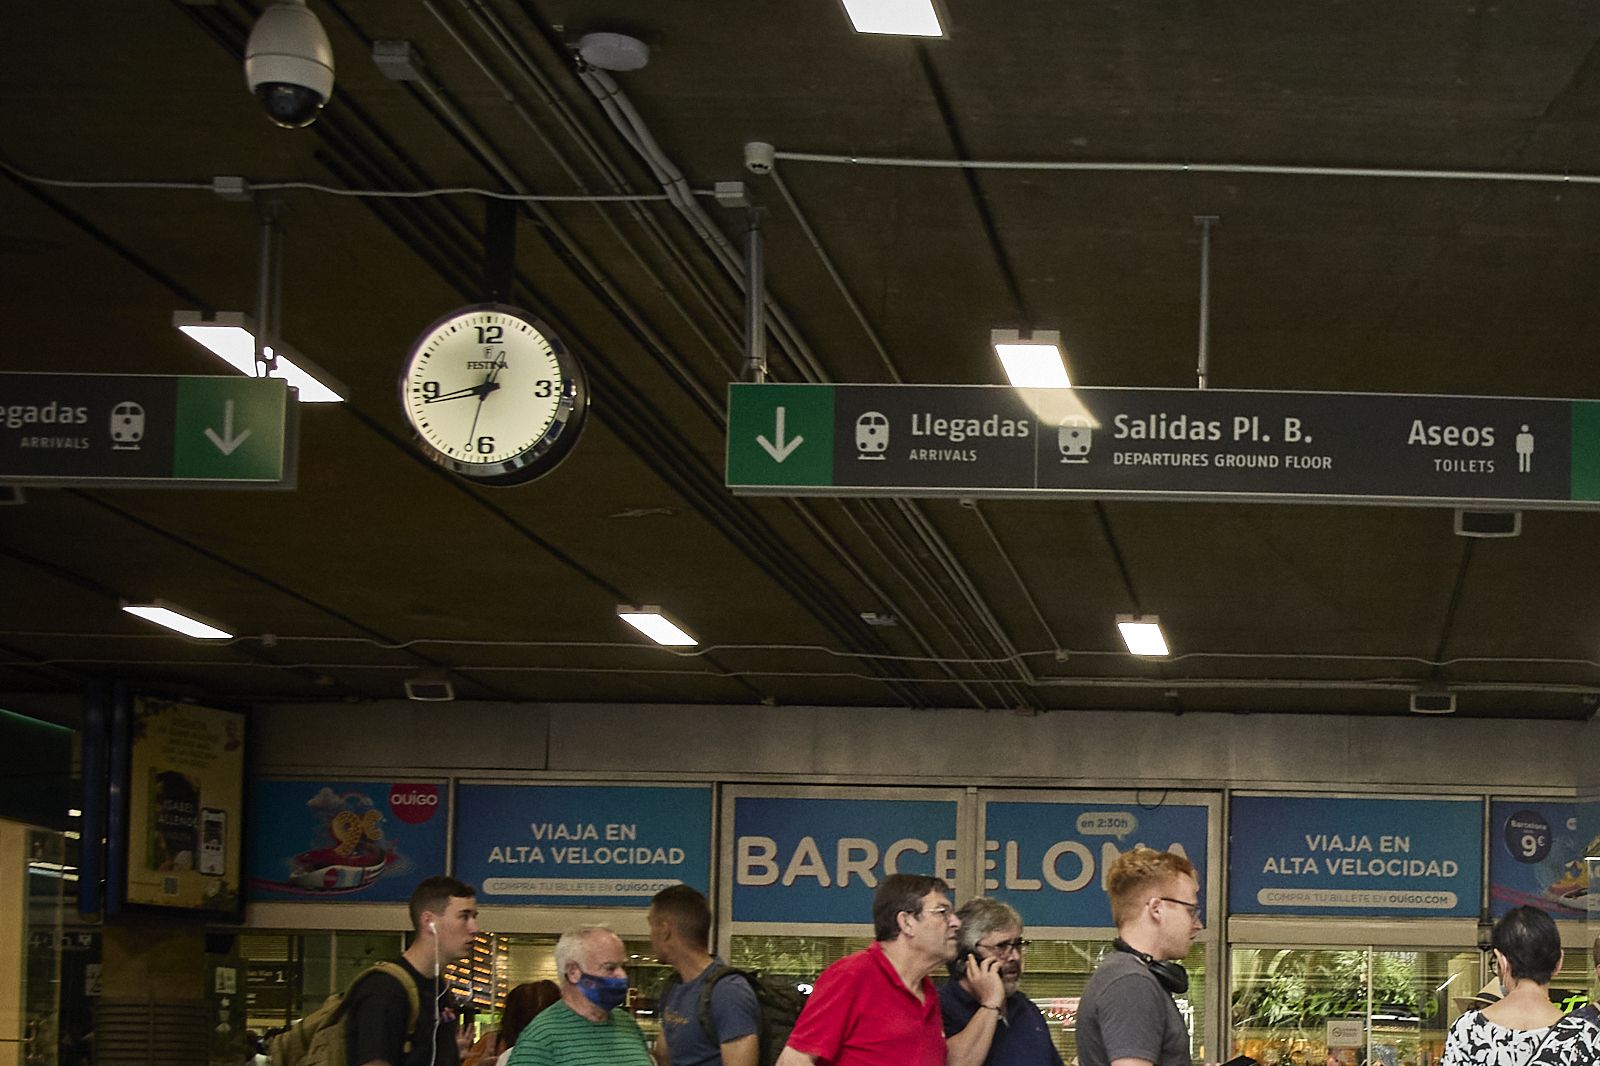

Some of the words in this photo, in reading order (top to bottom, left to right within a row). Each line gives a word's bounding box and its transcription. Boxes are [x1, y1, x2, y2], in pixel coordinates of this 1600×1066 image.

[474, 326, 504, 344] 12
[467, 361, 509, 370] FESTINA
[534, 380, 552, 398] 3
[911, 412, 1030, 442] Llegadas
[1113, 412, 1222, 441] Salidas
[1233, 415, 1271, 442] Pl.
[1284, 417, 1313, 443] B.
[1407, 418, 1496, 447] Aseos
[20, 436, 90, 449] ARRIVALS
[477, 436, 496, 454] 6
[908, 449, 978, 462] ARRIVALS
[1113, 452, 1209, 467] DEPARTURES
[1214, 453, 1280, 468] GROUND
[1285, 455, 1333, 469] FLOOR
[1433, 458, 1495, 473] TOILETS
[531, 823, 599, 841] VIAJA
[606, 823, 637, 840] EN
[1081, 820, 1094, 828] en
[1097, 818, 1128, 828] 2:30h
[1305, 834, 1373, 852] VIAJA
[1379, 835, 1411, 853] EN
[488, 846, 545, 864] ALTA
[551, 847, 685, 865] VELOCIDAD
[1262, 857, 1319, 875] ALTA
[1325, 858, 1458, 877] VELOCIDAD
[492, 881, 534, 891] COMPRA
[554, 882, 596, 892] BILLETE
[1266, 892, 1310, 902] COMPRA
[1314, 893, 1327, 903] TU
[1330, 893, 1369, 903] BILLETE
[1372, 894, 1387, 903] EN
